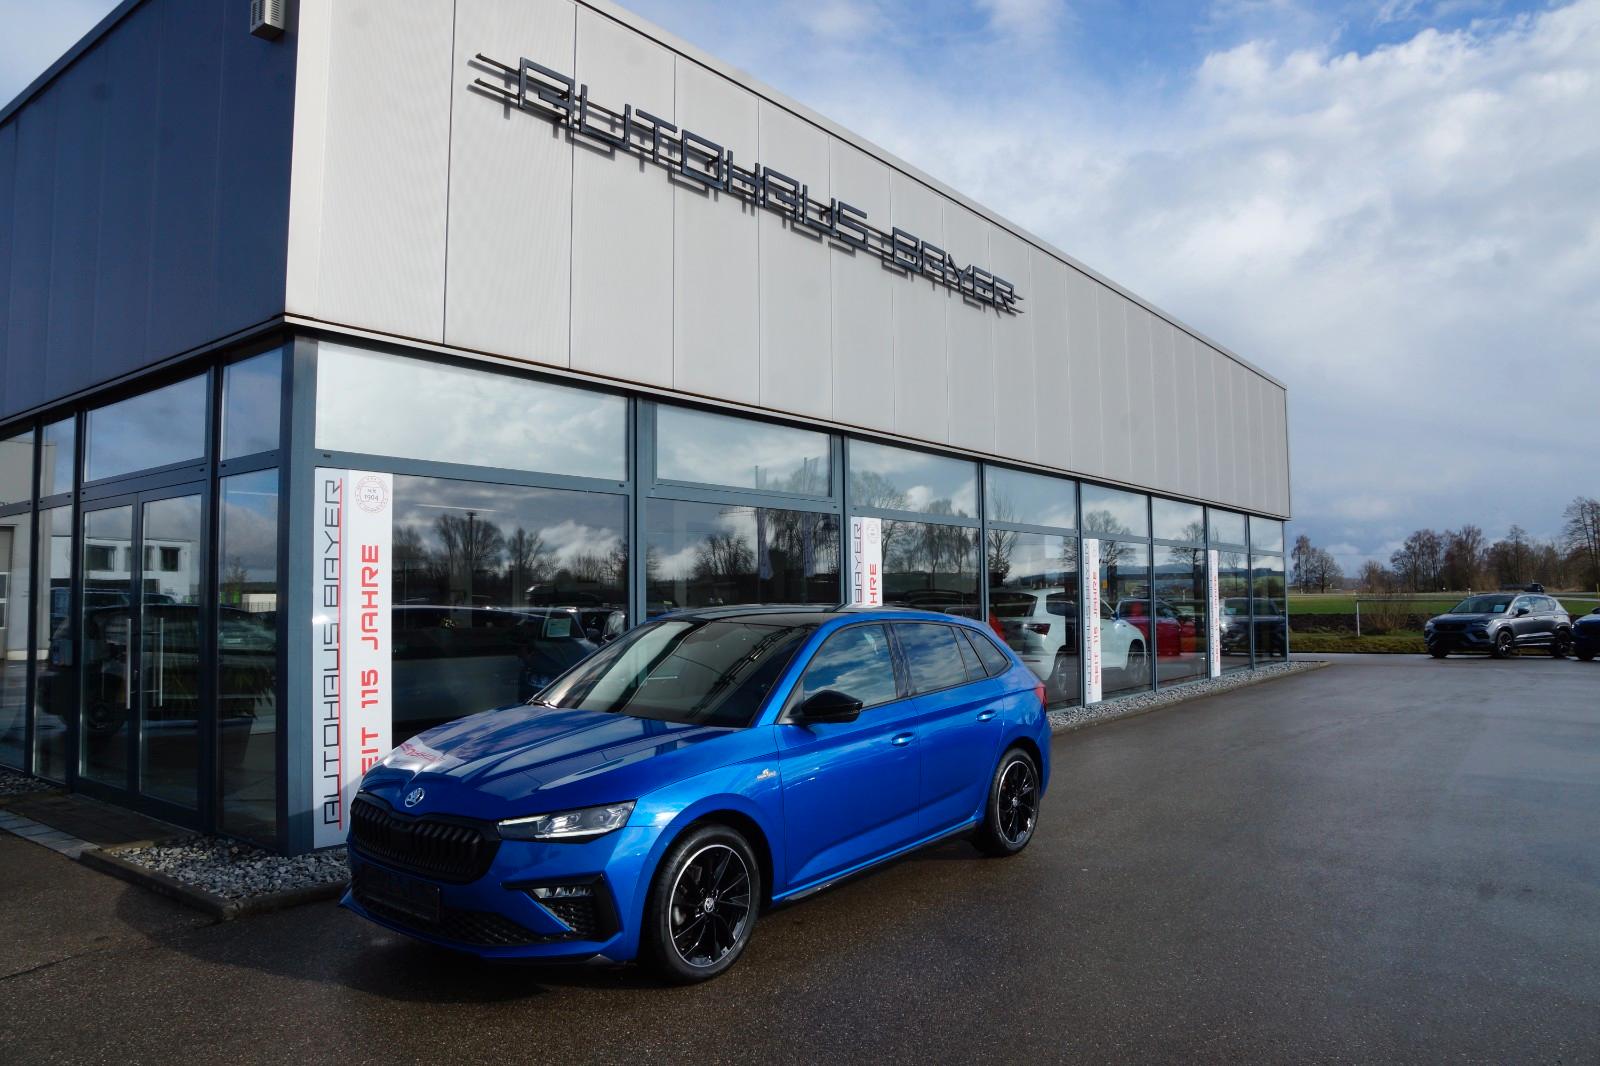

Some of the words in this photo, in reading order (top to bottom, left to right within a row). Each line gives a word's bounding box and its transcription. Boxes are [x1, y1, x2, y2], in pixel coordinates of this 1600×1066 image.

[519, 57, 868, 251] AUTOHAUS
[892, 226, 1016, 314] BAYER
[323, 480, 341, 607] BAYER
[869, 563, 877, 604] HRE
[361, 544, 379, 650] JAHRE
[323, 622, 341, 825] AUTOHAUS
[361, 669, 379, 709] 115
[361, 727, 379, 776] EIT
